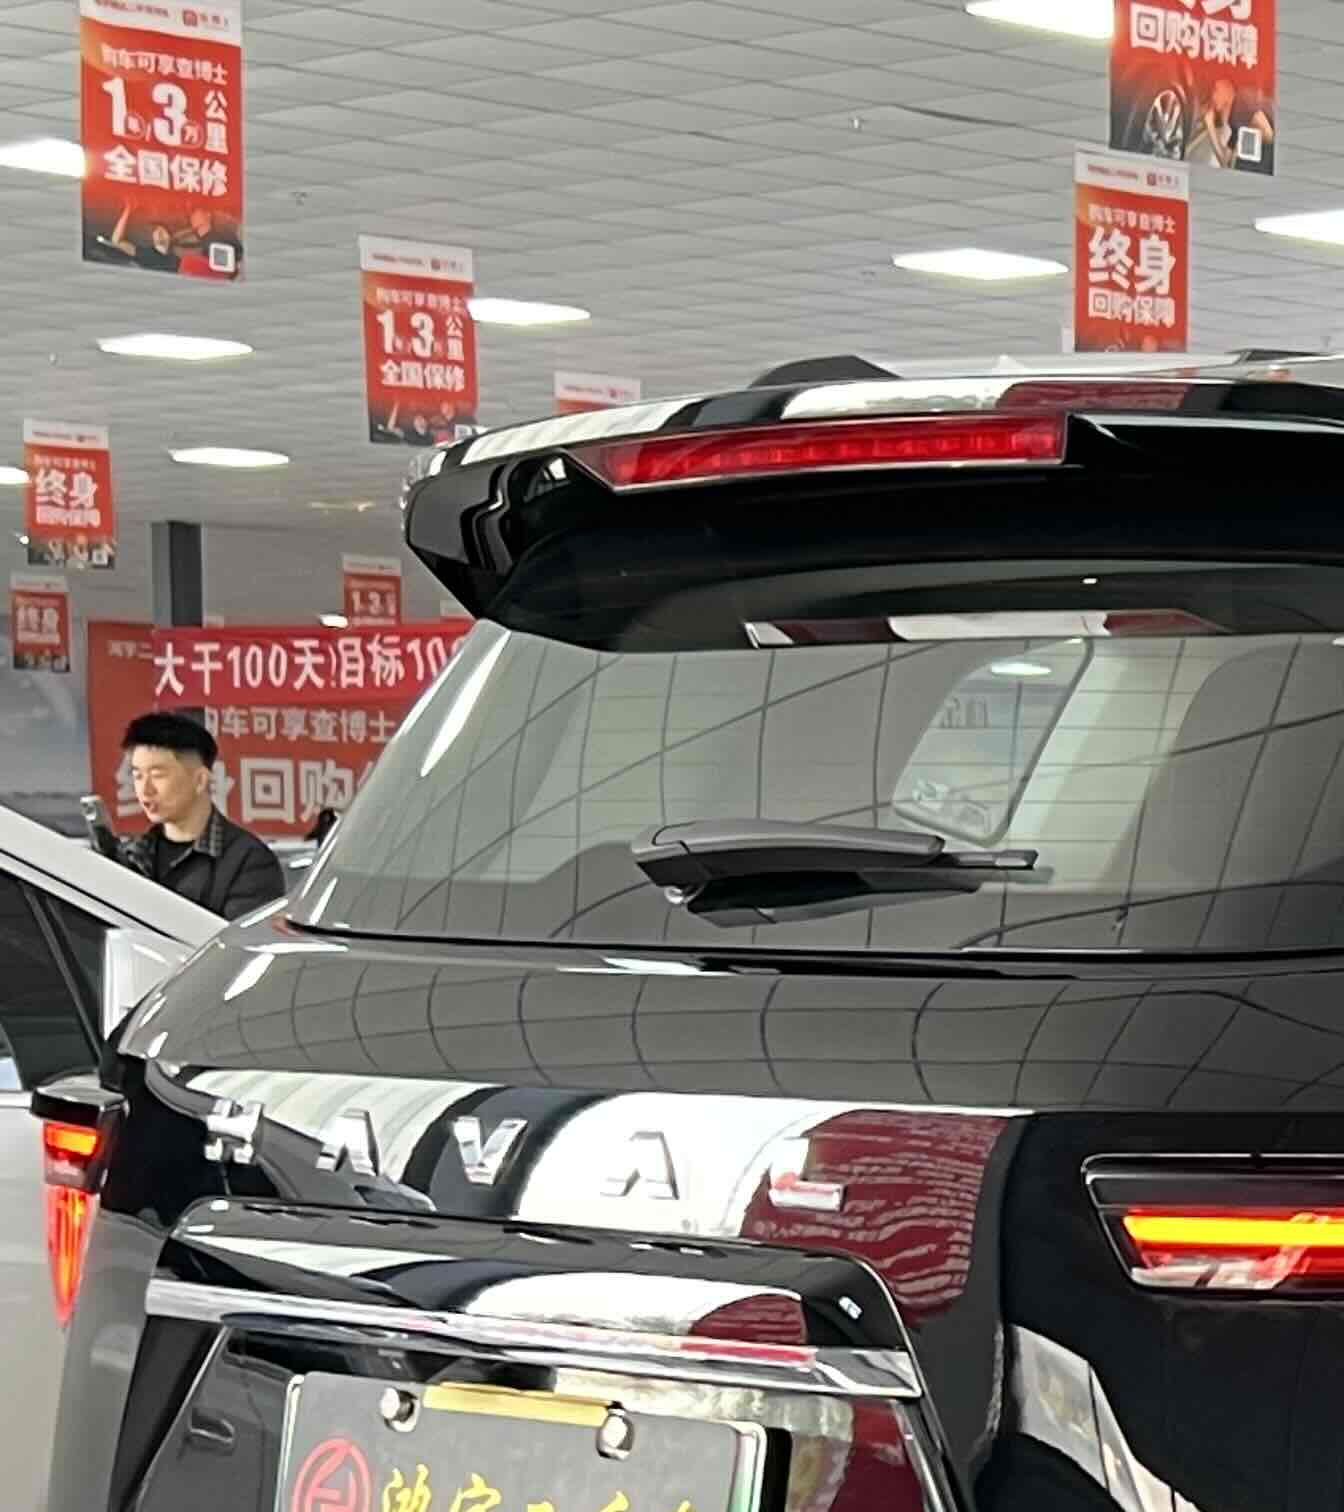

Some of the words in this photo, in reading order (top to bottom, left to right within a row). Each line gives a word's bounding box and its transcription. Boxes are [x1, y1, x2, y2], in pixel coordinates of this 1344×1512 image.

[1130, 2, 1258, 69] 回购保障
[103, 144, 229, 197] 全国保修
[1087, 224, 1177, 295] 终身
[380, 359, 465, 393] 全国保修
[34, 468, 98, 508] 终身
[205, 1098, 845, 1212] HAVAL
